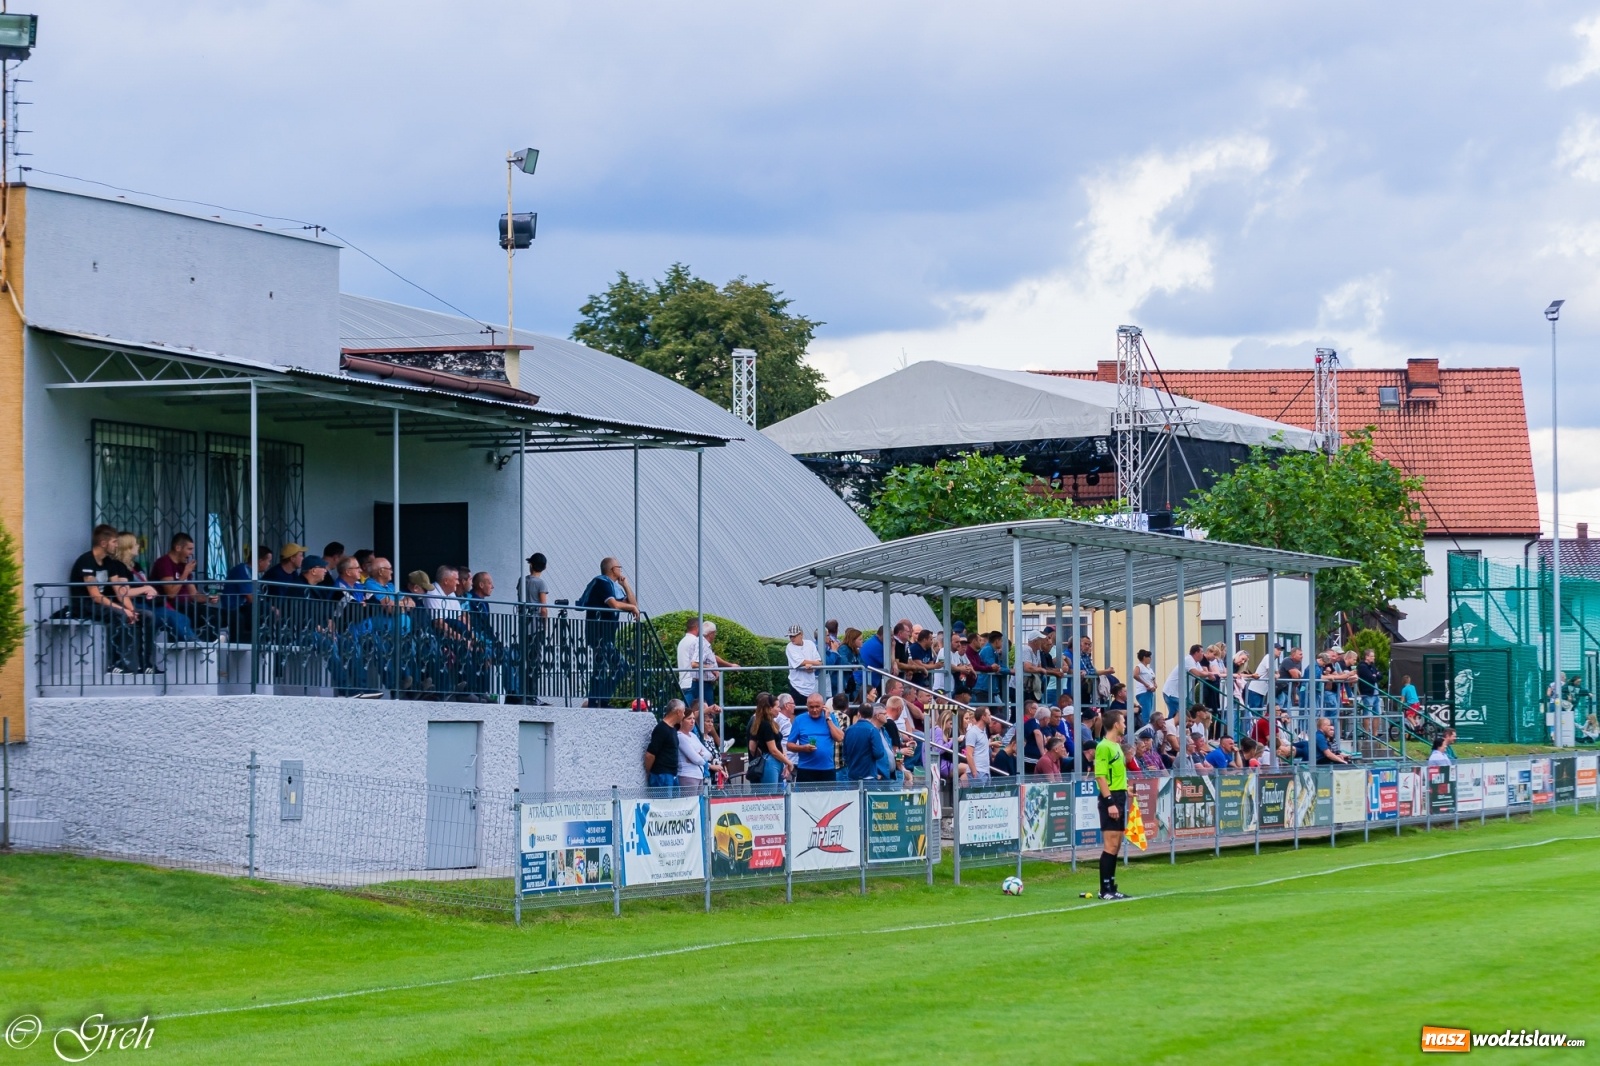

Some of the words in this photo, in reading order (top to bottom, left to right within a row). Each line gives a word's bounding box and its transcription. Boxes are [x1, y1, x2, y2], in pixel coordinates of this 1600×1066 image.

[555, 804, 563, 817] NA
[564, 803, 581, 818] TWOJE
[647, 818, 695, 837] KLIMATRONEX
